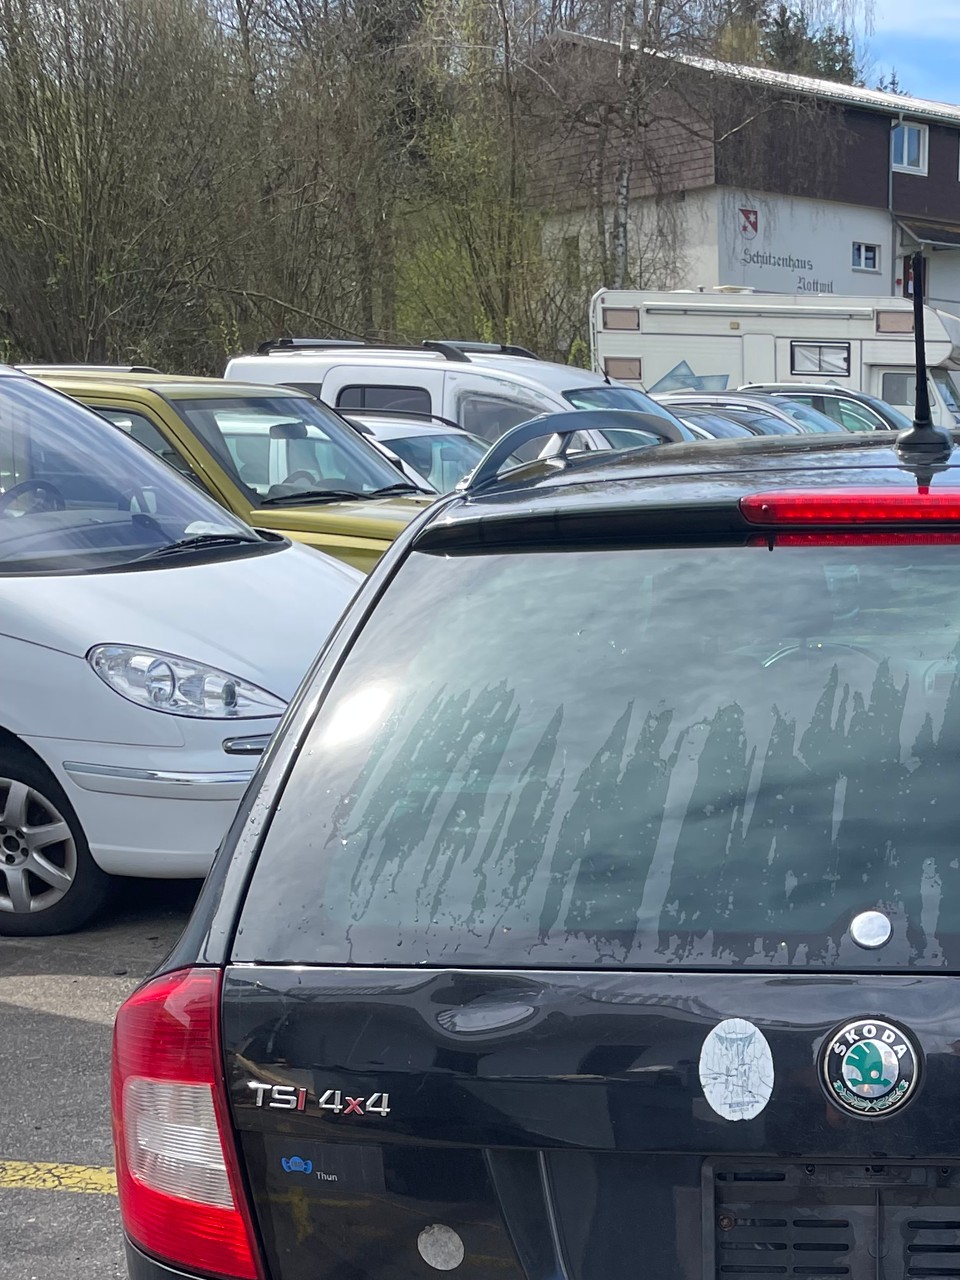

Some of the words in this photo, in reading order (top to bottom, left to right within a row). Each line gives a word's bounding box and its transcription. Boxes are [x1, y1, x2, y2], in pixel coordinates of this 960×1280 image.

[741, 248, 813, 272] Schützenhaus
[318, 1089, 391, 1117] 4x4
[315, 1171, 338, 1181] Thun
